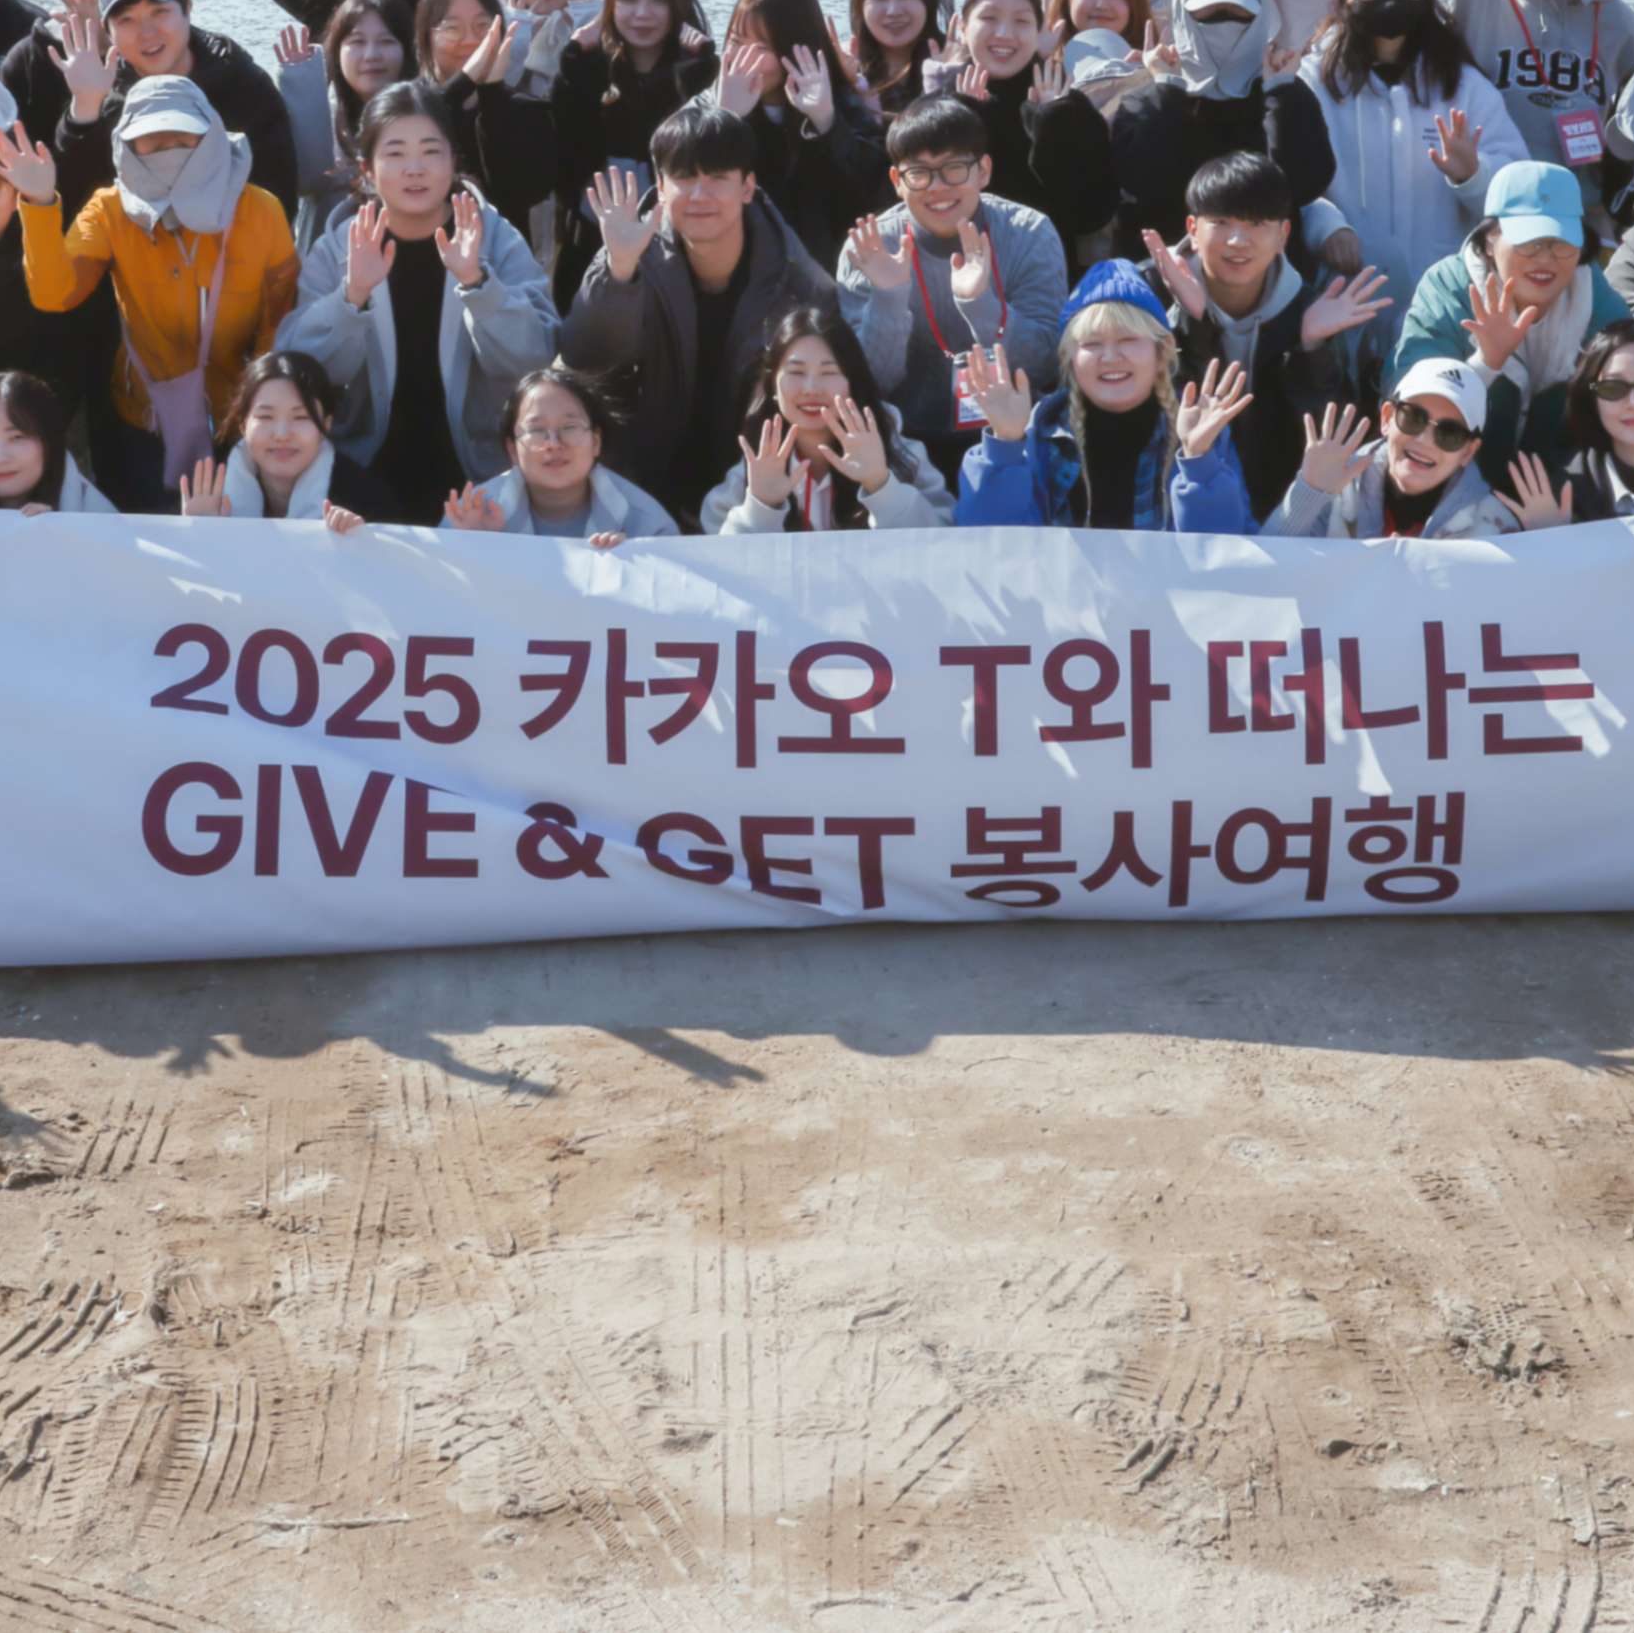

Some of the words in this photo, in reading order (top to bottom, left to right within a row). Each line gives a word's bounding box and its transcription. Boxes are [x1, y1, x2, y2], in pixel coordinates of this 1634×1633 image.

[151, 623, 481, 746] 2025
[518, 627, 907, 769] 카카오
[939, 628, 1171, 770] T와
[1206, 620, 1596, 766] 떠나는
[141, 761, 480, 879] GIVE
[515, 801, 610, 880] &
[635, 811, 917, 911] GET
[950, 790, 1467, 910] 봉사여행
